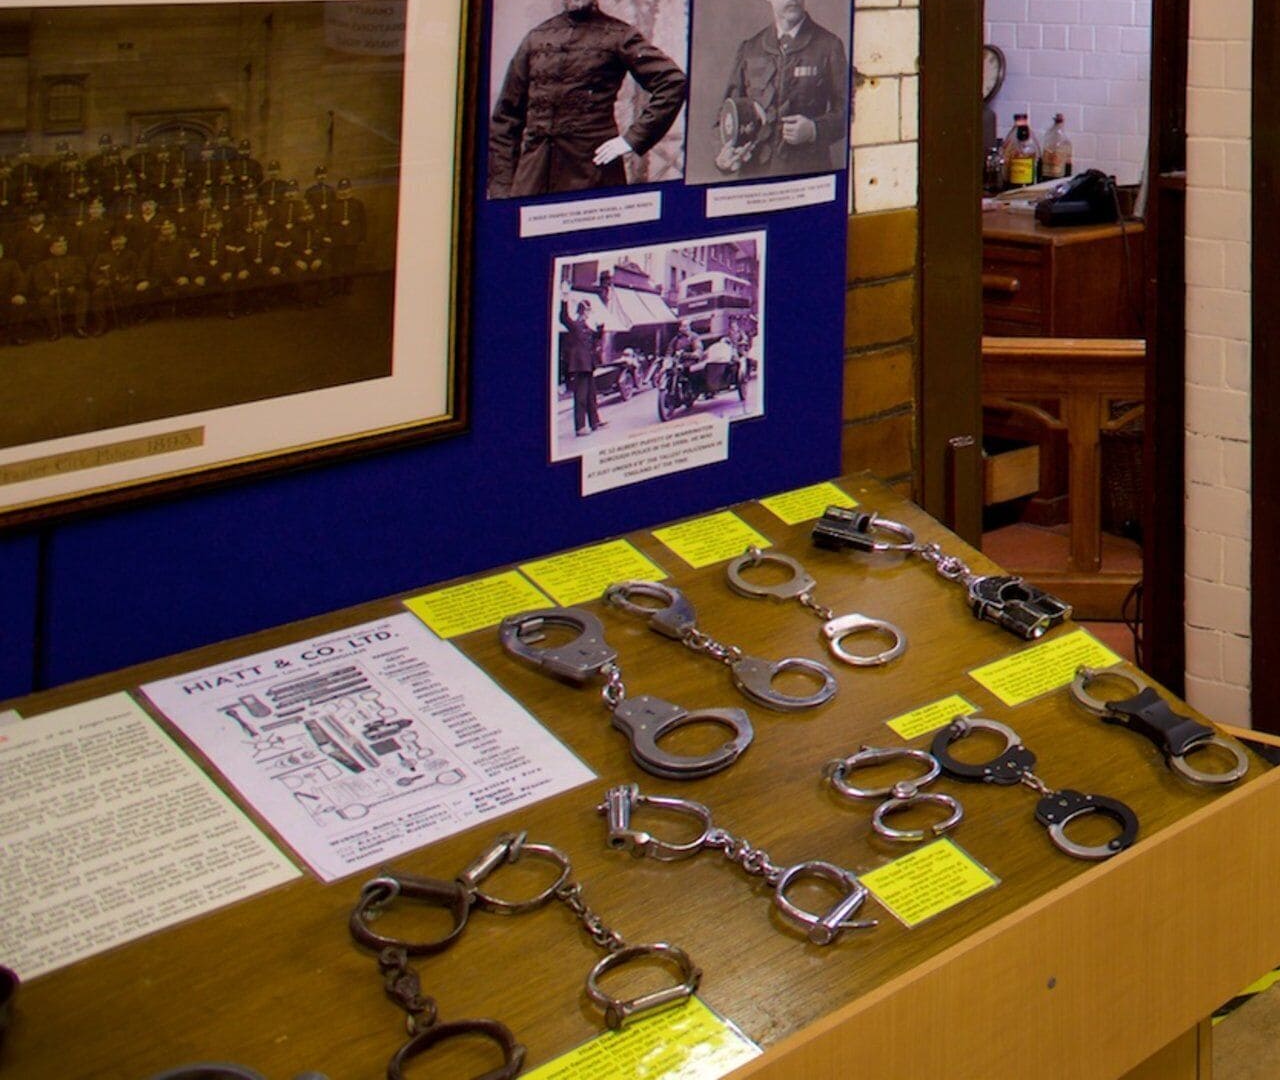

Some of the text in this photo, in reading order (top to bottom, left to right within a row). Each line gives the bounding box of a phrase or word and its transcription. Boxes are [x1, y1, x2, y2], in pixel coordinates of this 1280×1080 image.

[182, 630, 400, 695] HIATT & CO. LTD.
